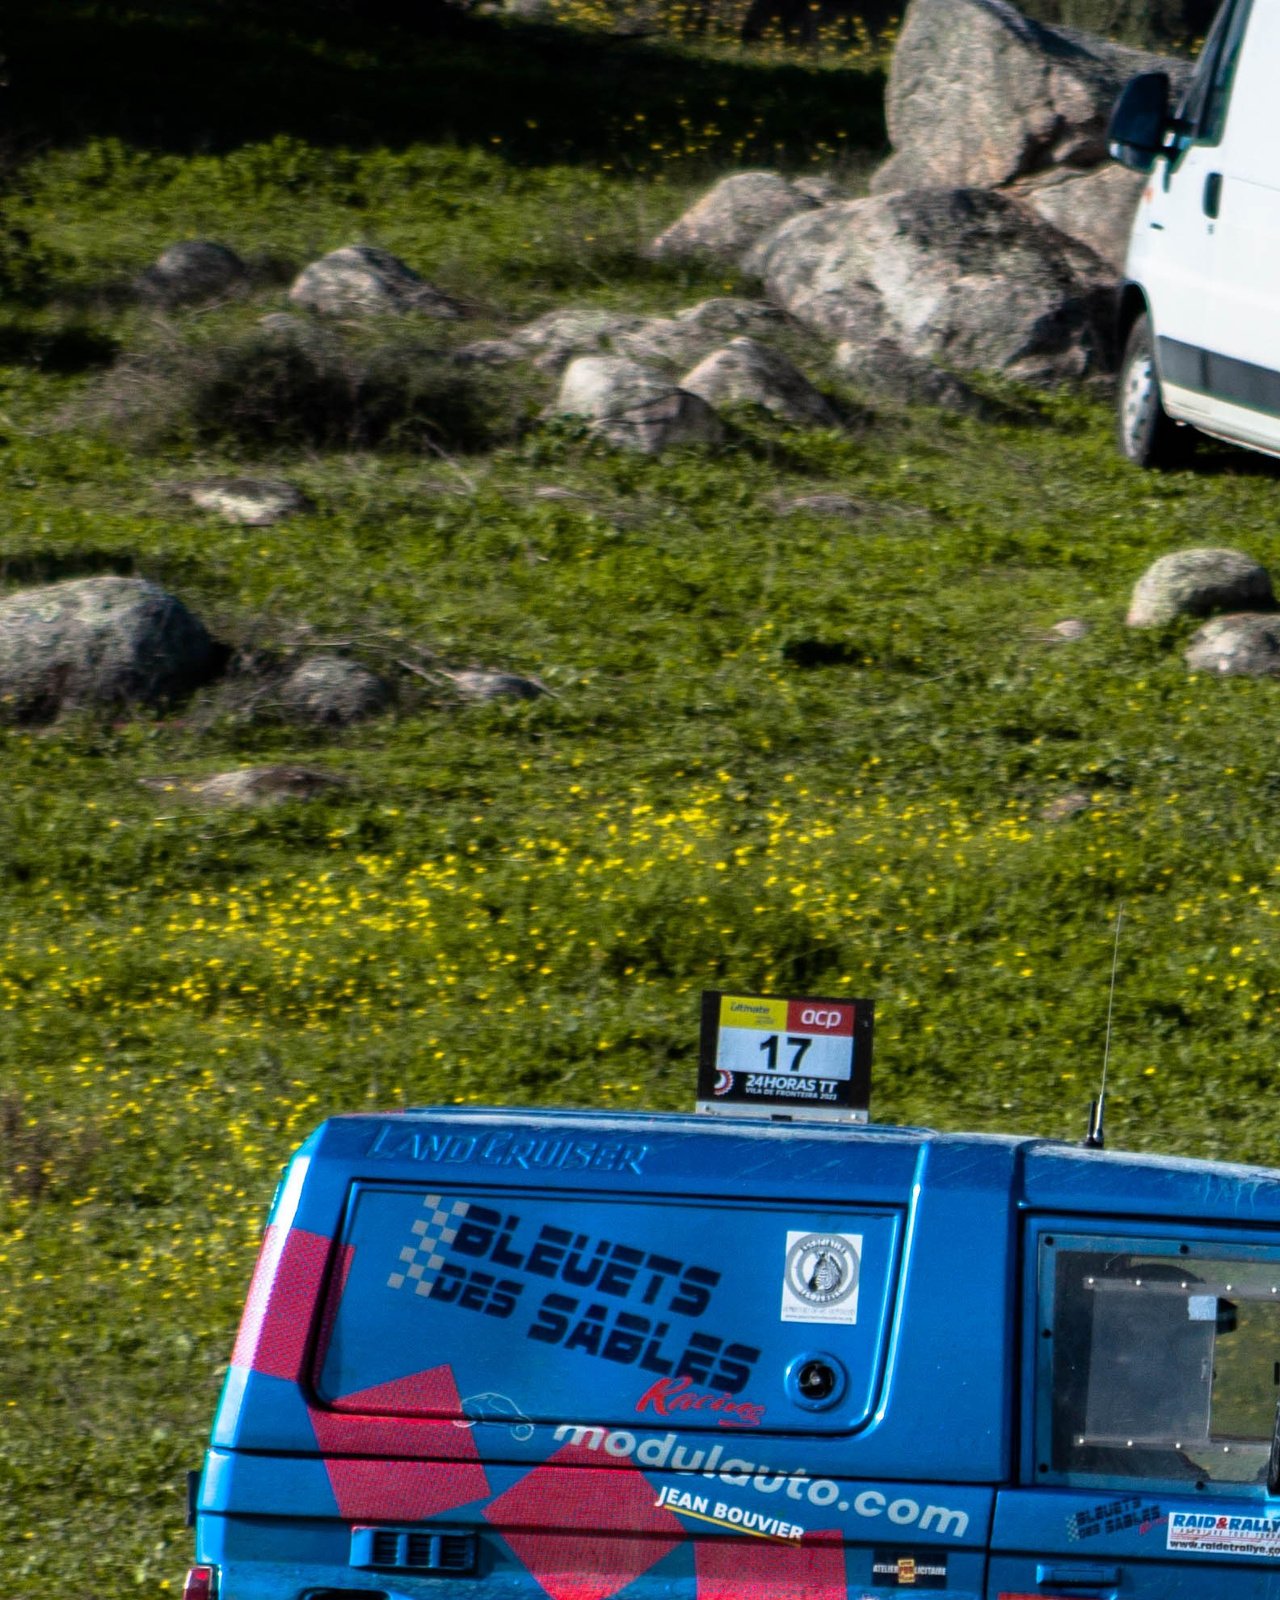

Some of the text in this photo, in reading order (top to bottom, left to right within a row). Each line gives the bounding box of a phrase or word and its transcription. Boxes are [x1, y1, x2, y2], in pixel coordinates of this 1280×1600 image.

[801, 1009, 842, 1028] acp
[760, 1035, 812, 1072] 17
[746, 1087, 763, 1096] VILA
[764, 1088, 774, 1096] DE
[776, 1090, 818, 1098] FRONTEIRA
[819, 1081, 838, 1094] TT
[367, 1125, 650, 1175] LAND CRUISER
[451, 1204, 722, 1318] BLEUETS
[429, 1263, 762, 1394] DES SABLES
[635, 1375, 766, 1428] Racing
[552, 1424, 970, 1537] modulauto.com
[655, 1486, 804, 1540] JEAN BOUVIER
[1076, 1497, 1141, 1526] BLEUETS
[1078, 1505, 1160, 1539] DES SABLES
